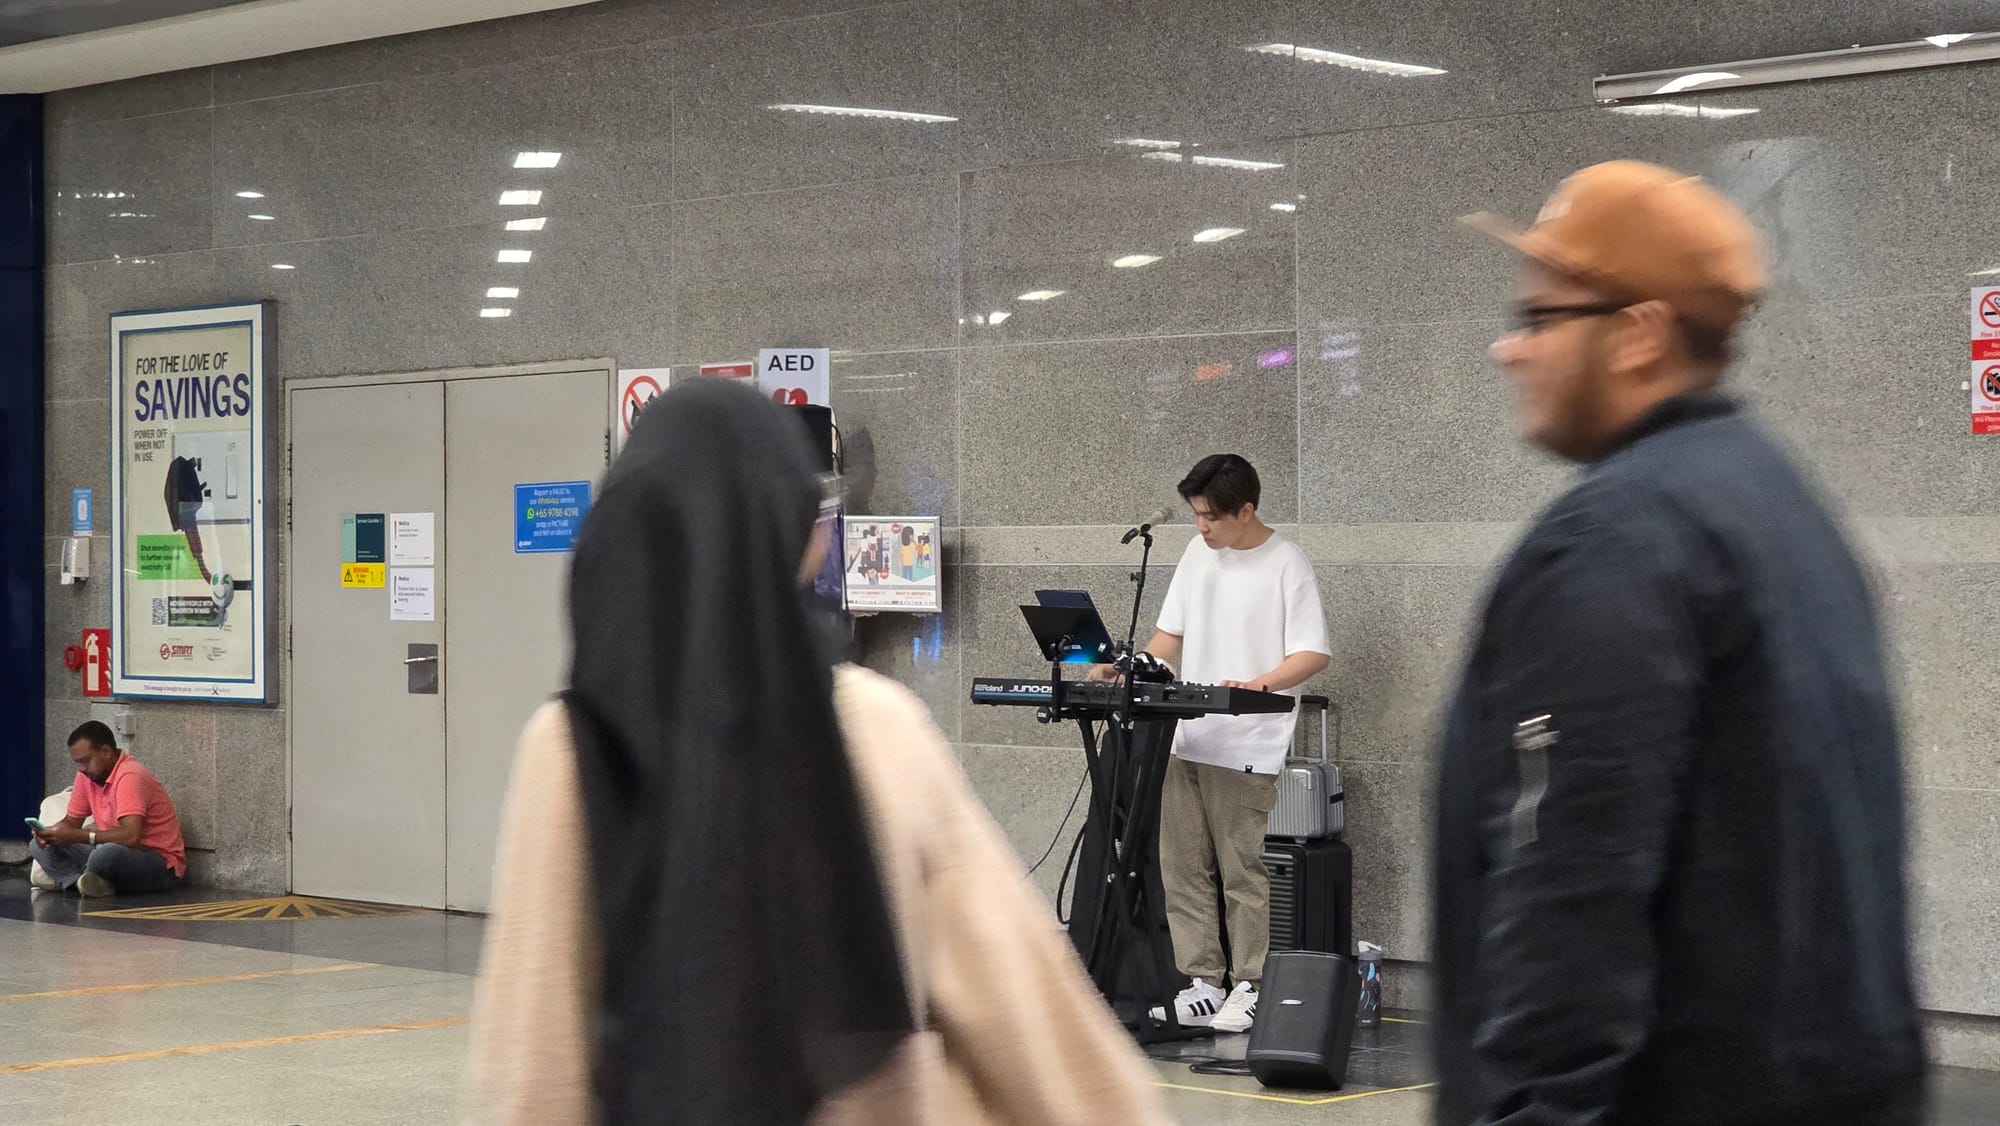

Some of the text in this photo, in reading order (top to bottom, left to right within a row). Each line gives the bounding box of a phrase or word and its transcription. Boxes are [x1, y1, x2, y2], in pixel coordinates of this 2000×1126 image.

[136, 351, 229, 375] FOR THE LOVE OF
[768, 355, 814, 371] AED
[135, 373, 250, 422] SAVINGS
[134, 428, 168, 439] POWER OFF
[134, 440, 165, 450] WHEN NOT
[134, 452, 153, 461] IN USE
[171, 645, 194, 655] SMRT
[982, 684, 1004, 692] Roland
